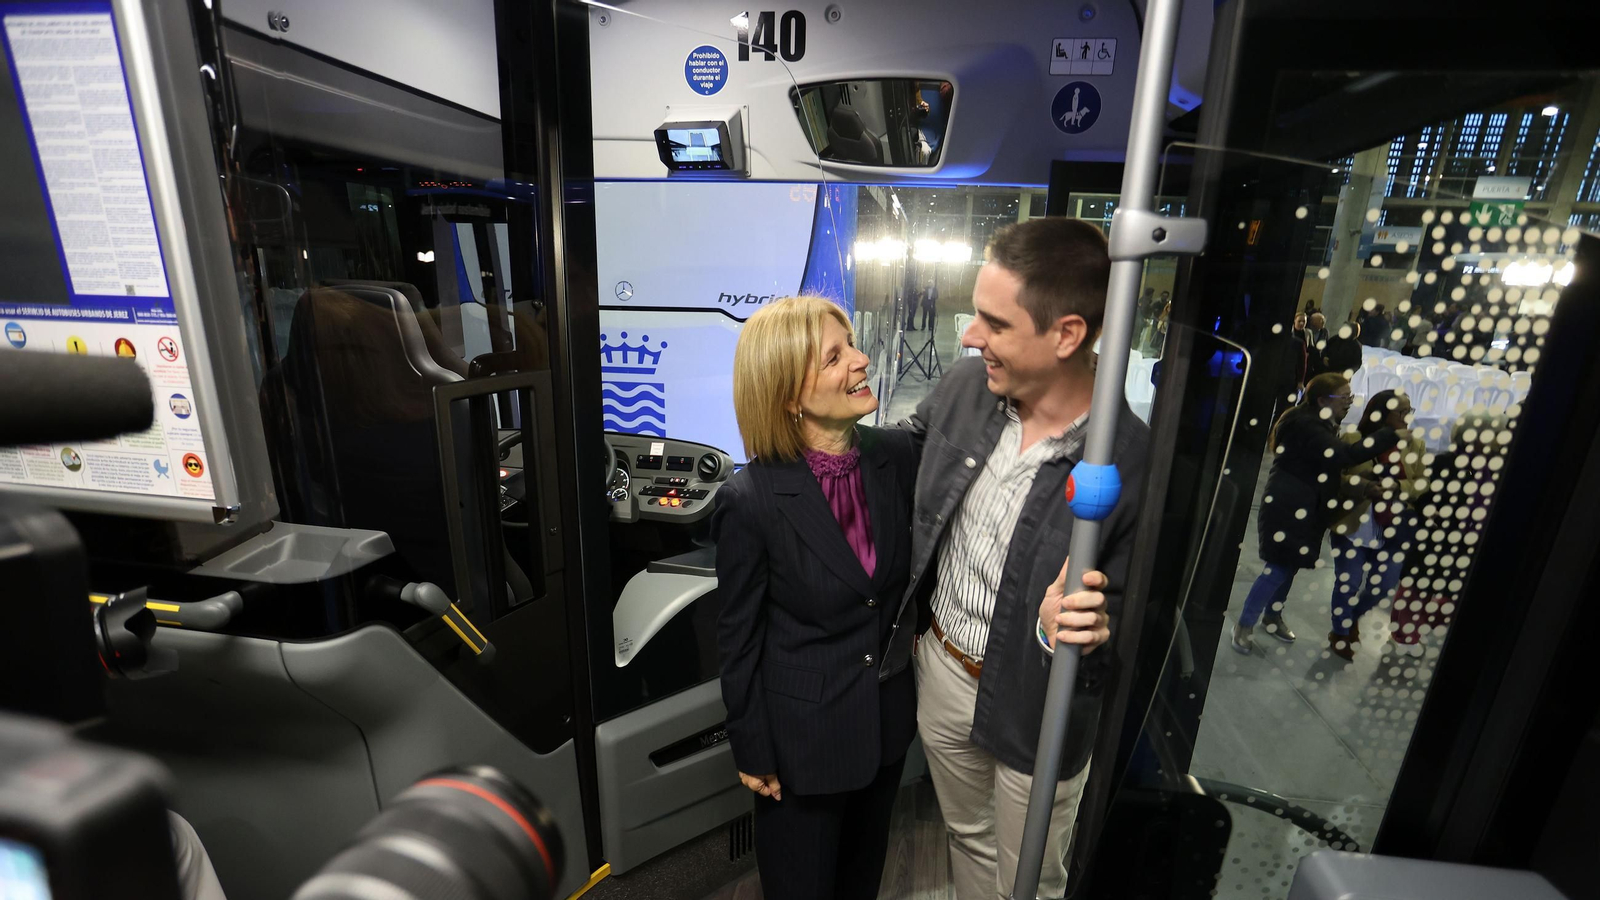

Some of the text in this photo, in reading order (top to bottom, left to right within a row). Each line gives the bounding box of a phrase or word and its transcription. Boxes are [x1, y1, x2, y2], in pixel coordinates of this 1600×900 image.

[729, 10, 806, 62] 140
[21, 307, 44, 316] SERVICIO
[44, 308, 51, 317] DE
[52, 308, 80, 317] AUTOBUSES
[80, 309, 105, 318] URBANOS
[105, 310, 113, 319] DE
[113, 310, 129, 319] JEREZ
[700, 729, 729, 748] Merce
